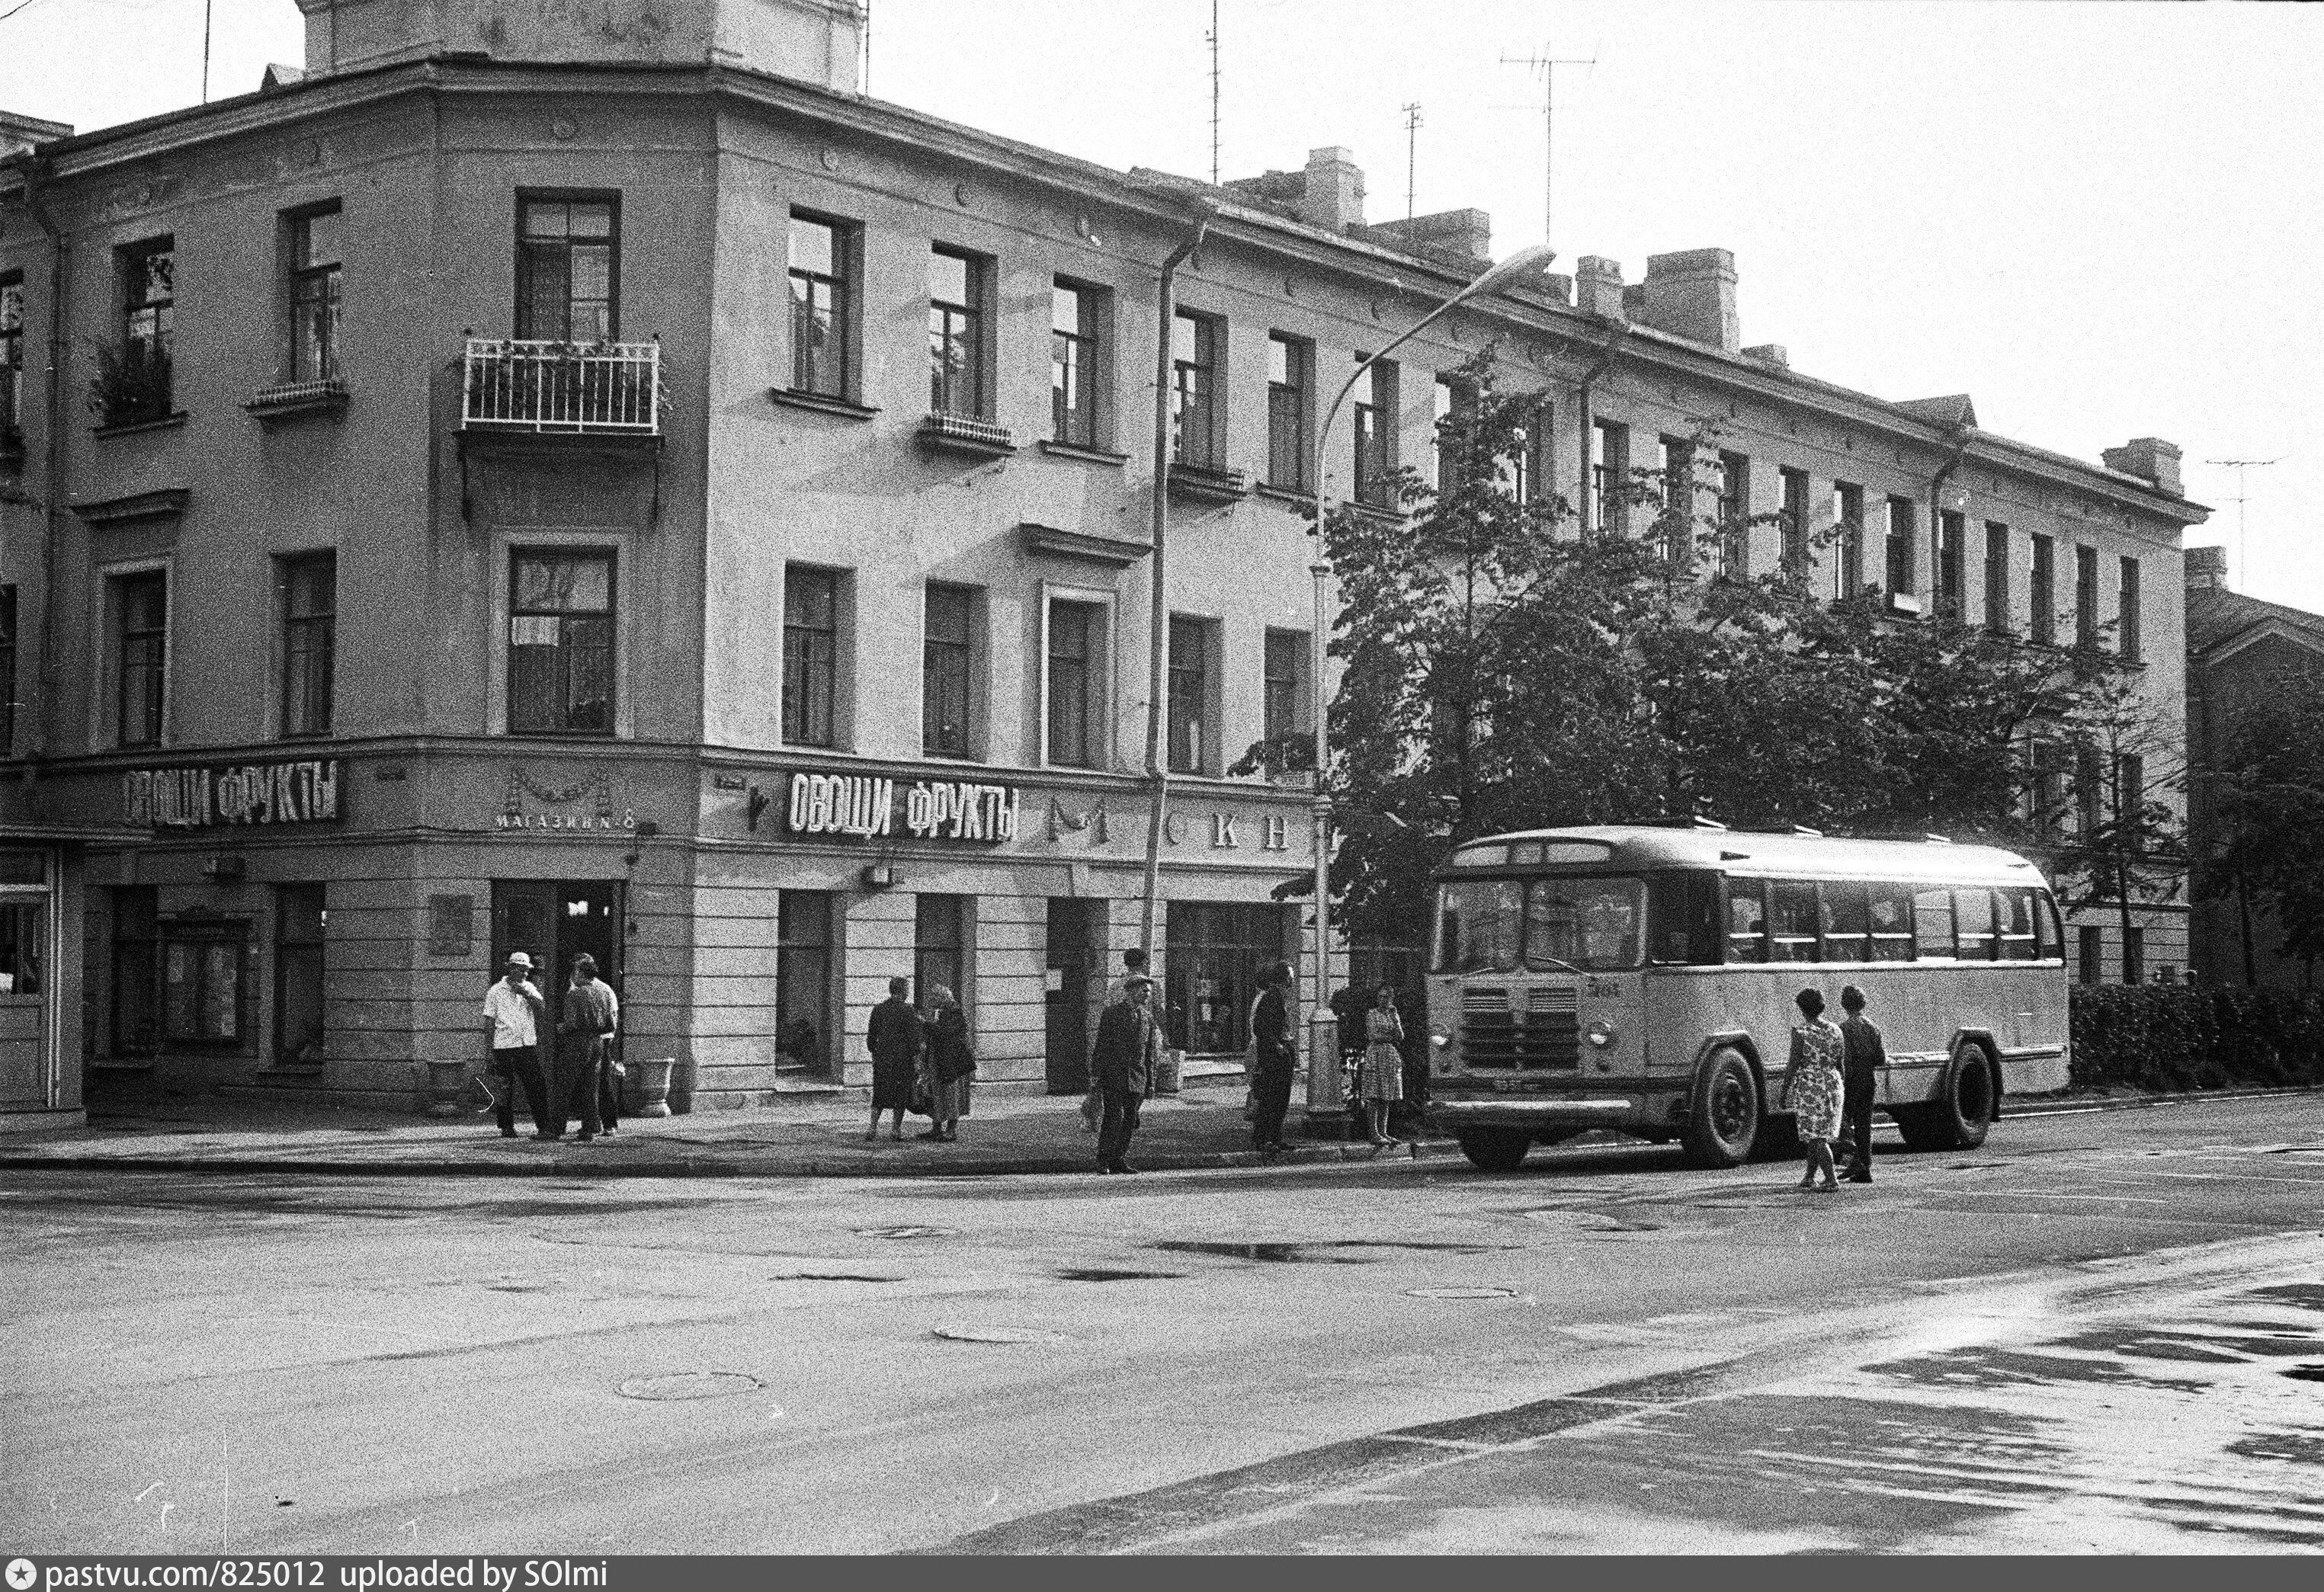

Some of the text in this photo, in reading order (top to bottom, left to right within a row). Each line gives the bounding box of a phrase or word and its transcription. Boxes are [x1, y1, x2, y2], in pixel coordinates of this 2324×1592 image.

[122, 760, 338, 829] ОВОЩИ ФРУКТЫ
[495, 814, 592, 828] МАГАЗИН
[790, 773, 1019, 841] ОВОЩИ ФРУКТЫ
